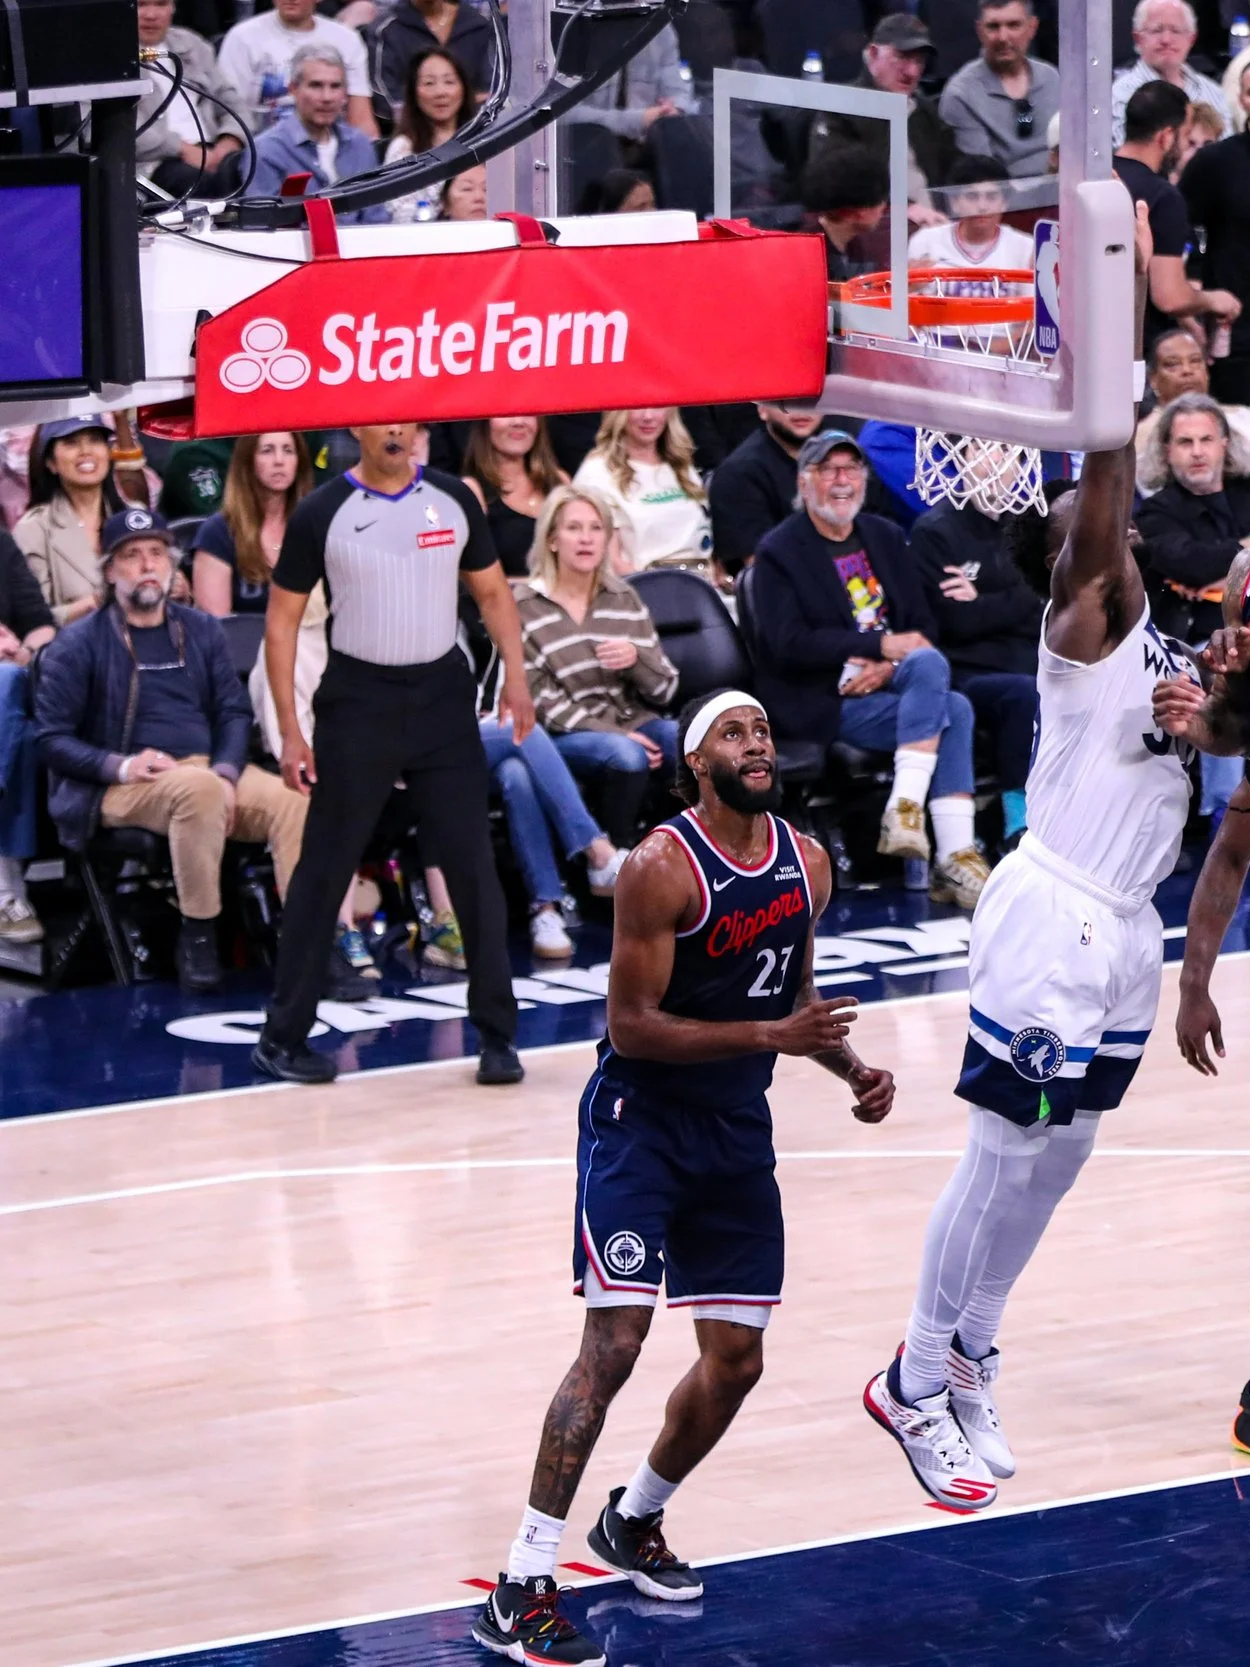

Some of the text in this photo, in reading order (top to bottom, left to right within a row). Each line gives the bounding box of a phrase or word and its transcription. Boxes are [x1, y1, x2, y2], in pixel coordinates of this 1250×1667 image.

[1040, 326, 1057, 348] NBA
[775, 872, 801, 881] RWANDA
[779, 865, 795, 873] VISIT
[706, 886, 804, 957] Clippers
[748, 944, 795, 997] 23
[1011, 1028, 1040, 1055] MINNESOTA
